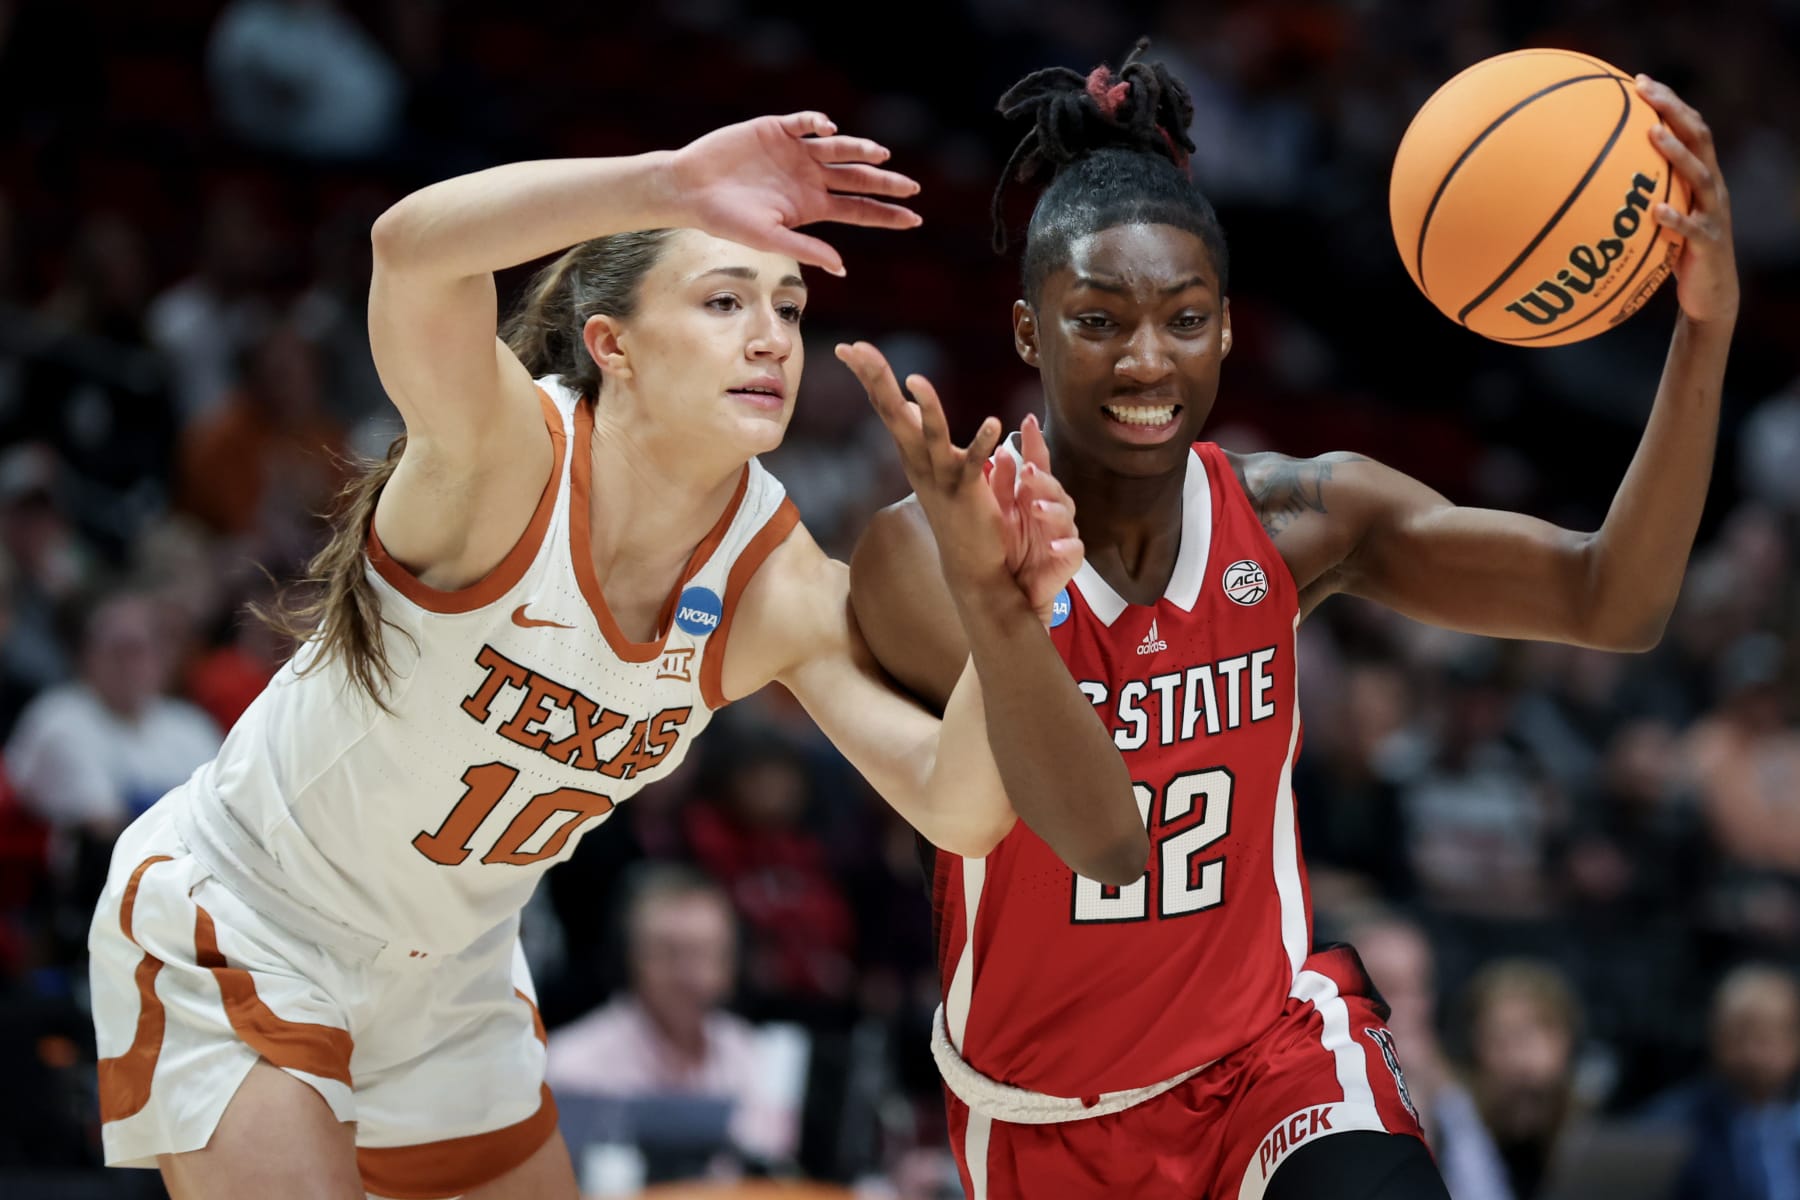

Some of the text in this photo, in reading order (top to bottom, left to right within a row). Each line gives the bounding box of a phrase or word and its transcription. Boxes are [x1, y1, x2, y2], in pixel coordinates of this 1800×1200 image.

[1504, 172, 1657, 325] Wilson
[678, 606, 719, 628] NCAA
[1231, 572, 1264, 589] ACC
[1136, 639, 1168, 656] adidas
[460, 643, 693, 780] TEXAS
[1112, 644, 1278, 752] STATE
[411, 761, 615, 866] 10
[1259, 1106, 1334, 1181] PACK
